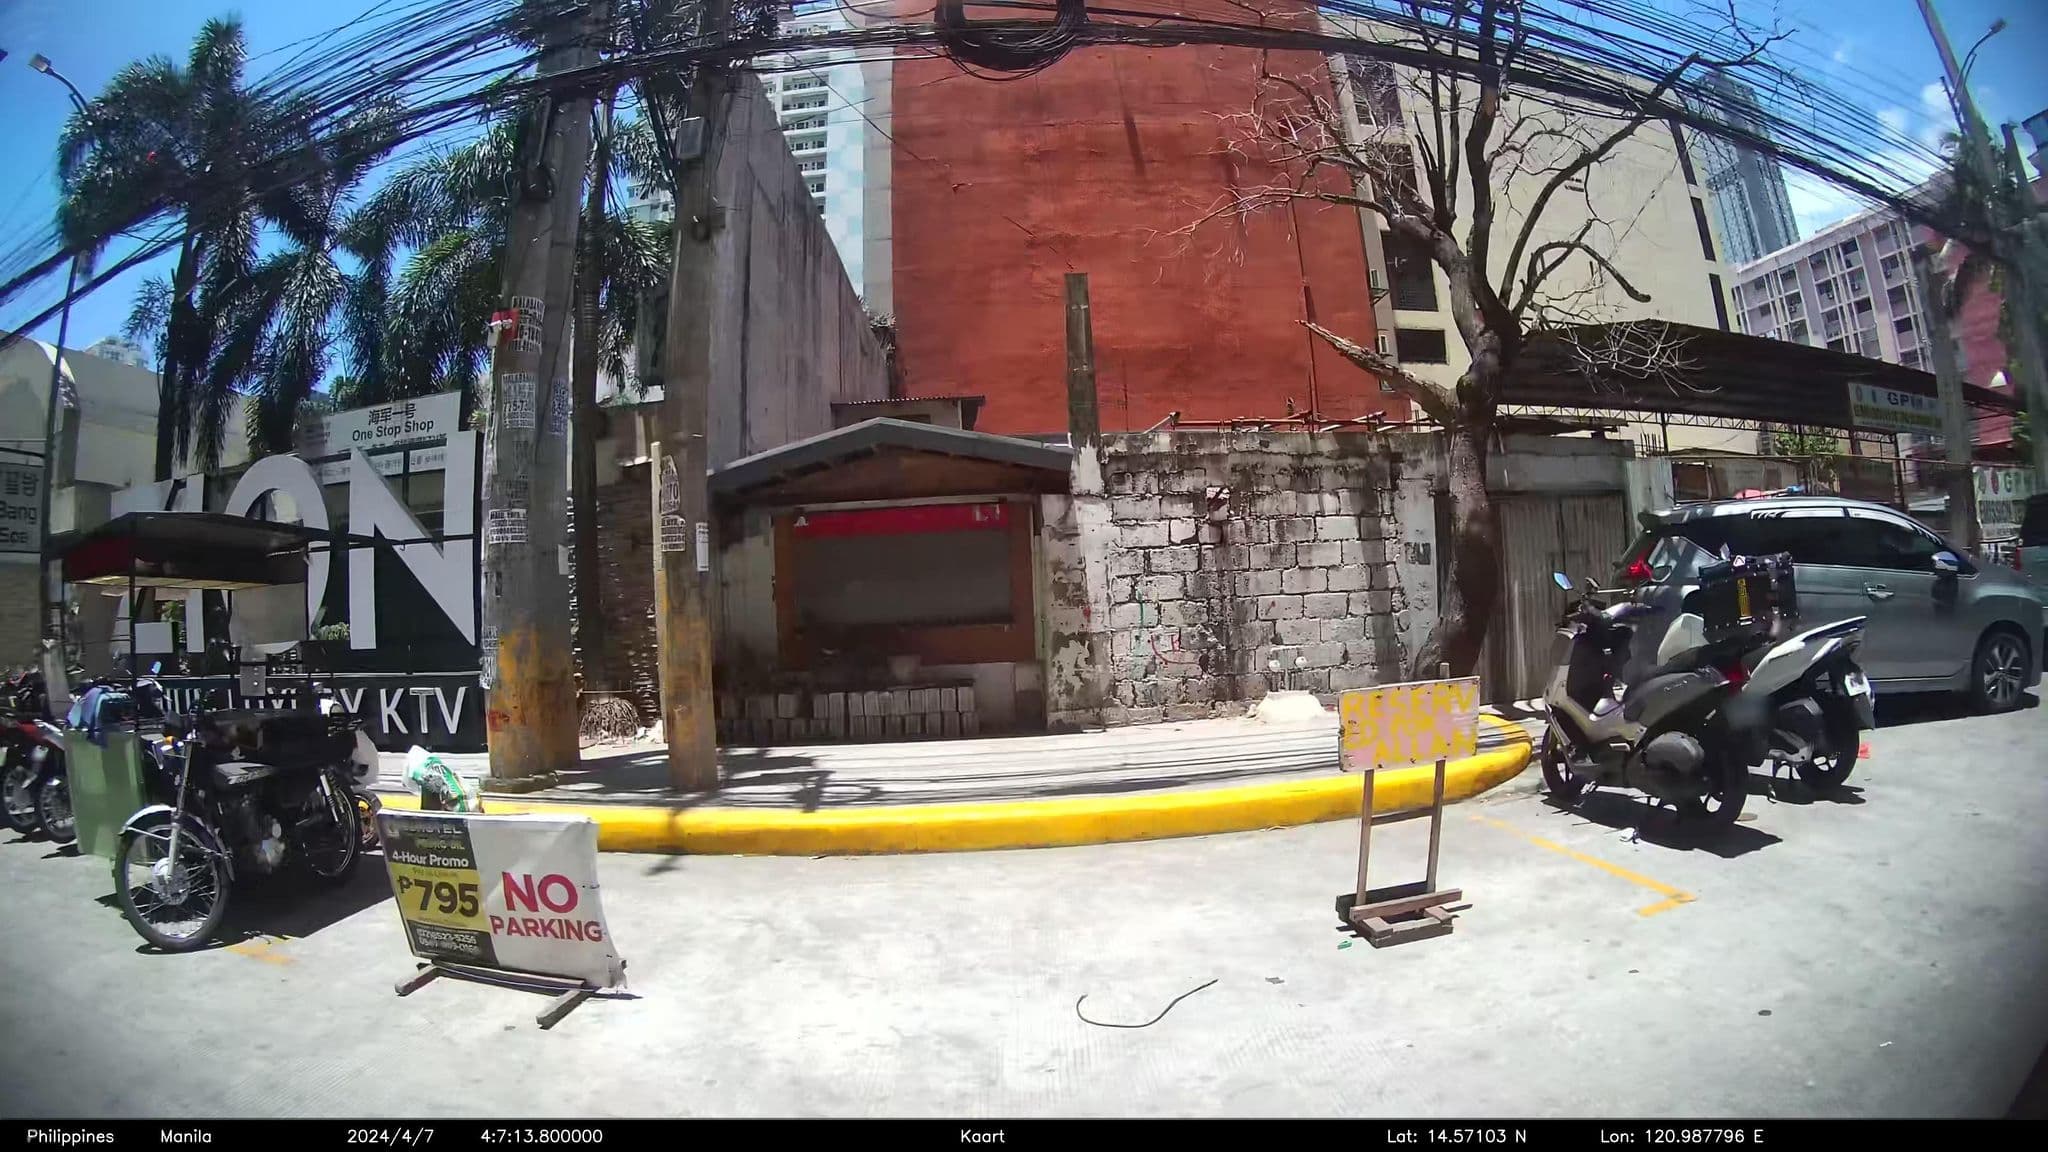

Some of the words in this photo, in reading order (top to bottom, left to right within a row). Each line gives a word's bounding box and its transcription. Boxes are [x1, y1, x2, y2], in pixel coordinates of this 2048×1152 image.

[352, 429, 373, 442] One
[376, 424, 401, 438] Stop
[404, 419, 434, 433] Shop
[379, 686, 467, 735] KTV
[392, 850, 427, 865] 4-Hour
[429, 853, 469, 868] Promo
[502, 871, 578, 914] NO
[489, 915, 605, 942] PARKING
